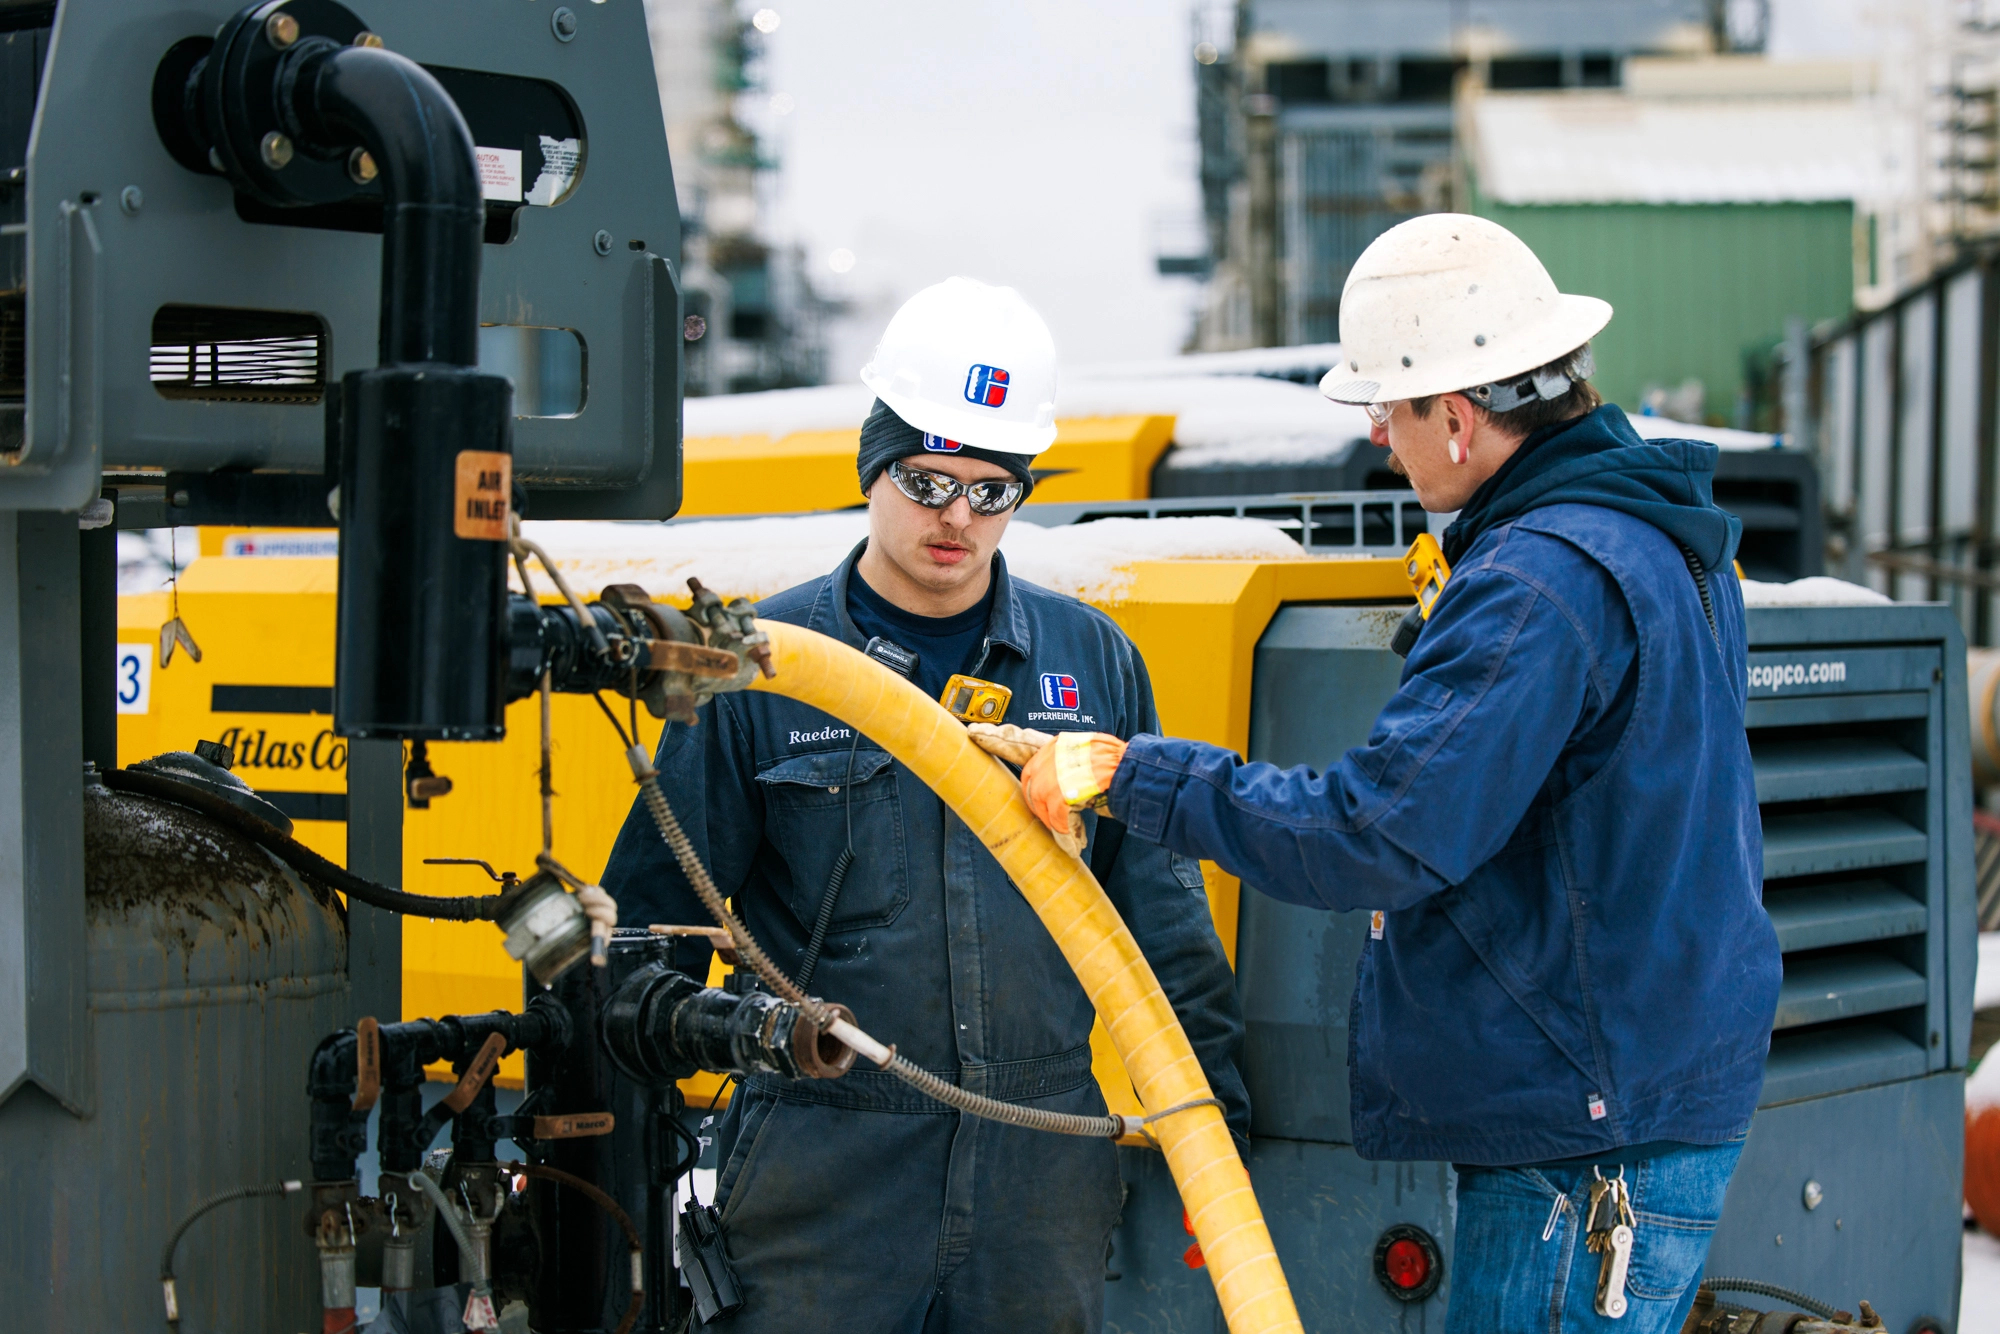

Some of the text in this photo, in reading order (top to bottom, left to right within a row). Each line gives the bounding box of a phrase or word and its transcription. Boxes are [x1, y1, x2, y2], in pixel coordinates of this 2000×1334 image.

[476, 153, 500, 162] AUTION
[119, 655, 140, 704] 3
[1081, 714, 1096, 725] INC.
[788, 725, 851, 745] Raeden
